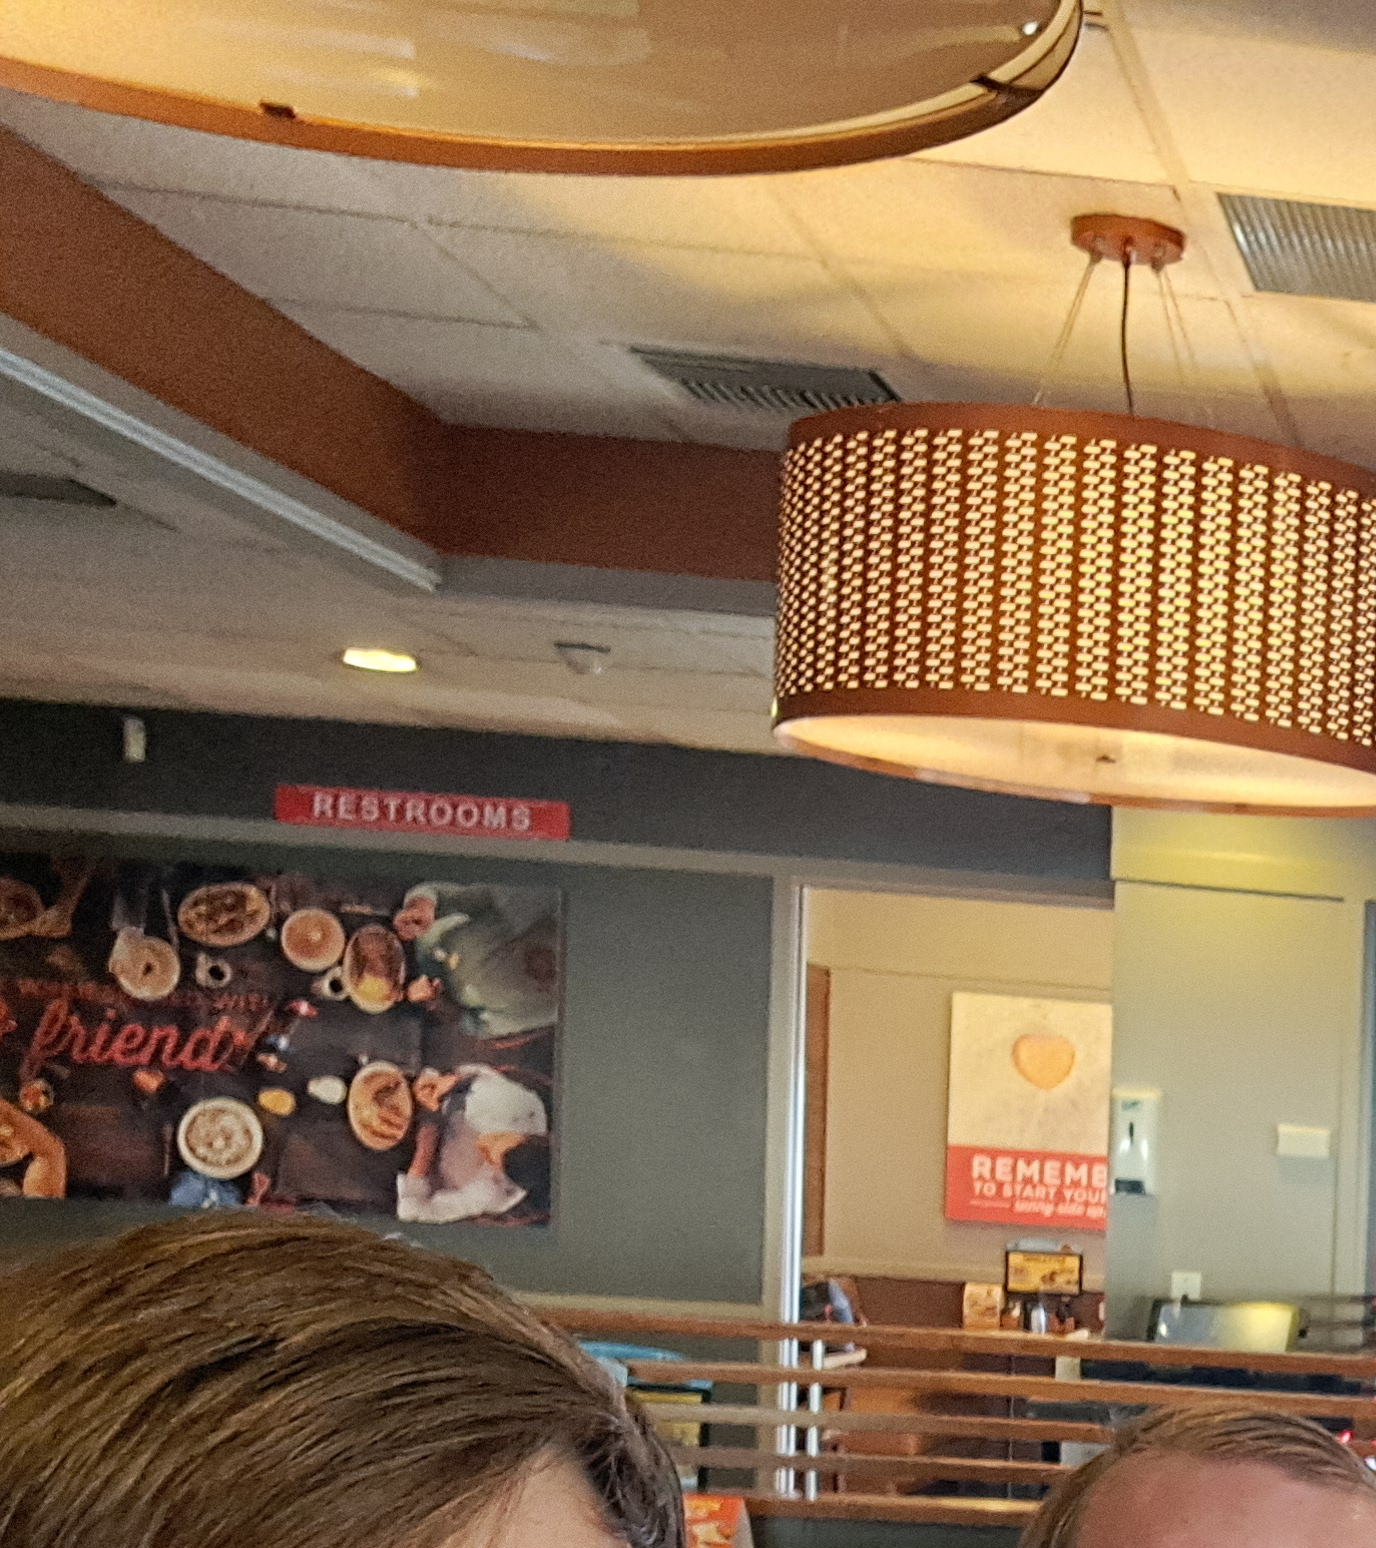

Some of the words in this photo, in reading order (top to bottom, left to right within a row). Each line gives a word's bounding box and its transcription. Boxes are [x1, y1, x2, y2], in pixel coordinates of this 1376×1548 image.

[312, 790, 532, 832] RESTROOMS
[973, 1180, 997, 1197] TO
[1002, 1182, 1058, 1200] START
